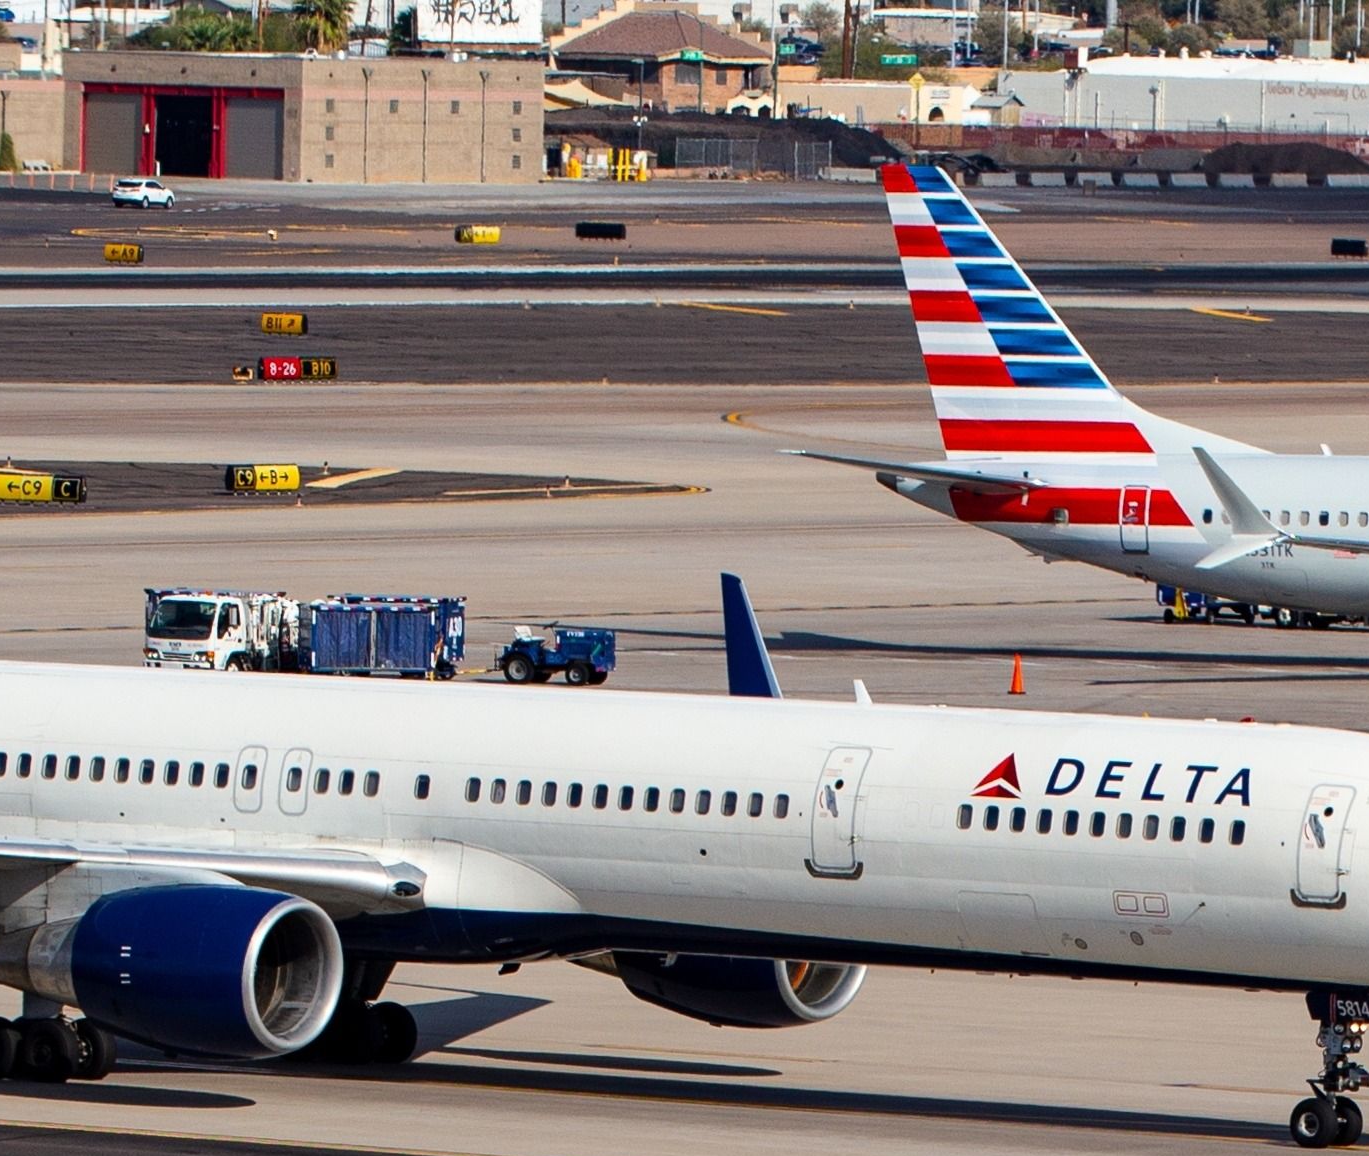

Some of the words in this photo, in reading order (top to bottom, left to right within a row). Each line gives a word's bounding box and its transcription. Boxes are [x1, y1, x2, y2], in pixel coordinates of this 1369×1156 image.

[265, 317, 282, 329] B11
[270, 362, 296, 376] 8-26
[311, 361, 331, 375] B10
[237, 470, 254, 485] C9
[270, 469, 278, 484] B
[22, 480, 42, 495] C9
[61, 482, 70, 496] C
[1044, 758, 1251, 807] DELTA
